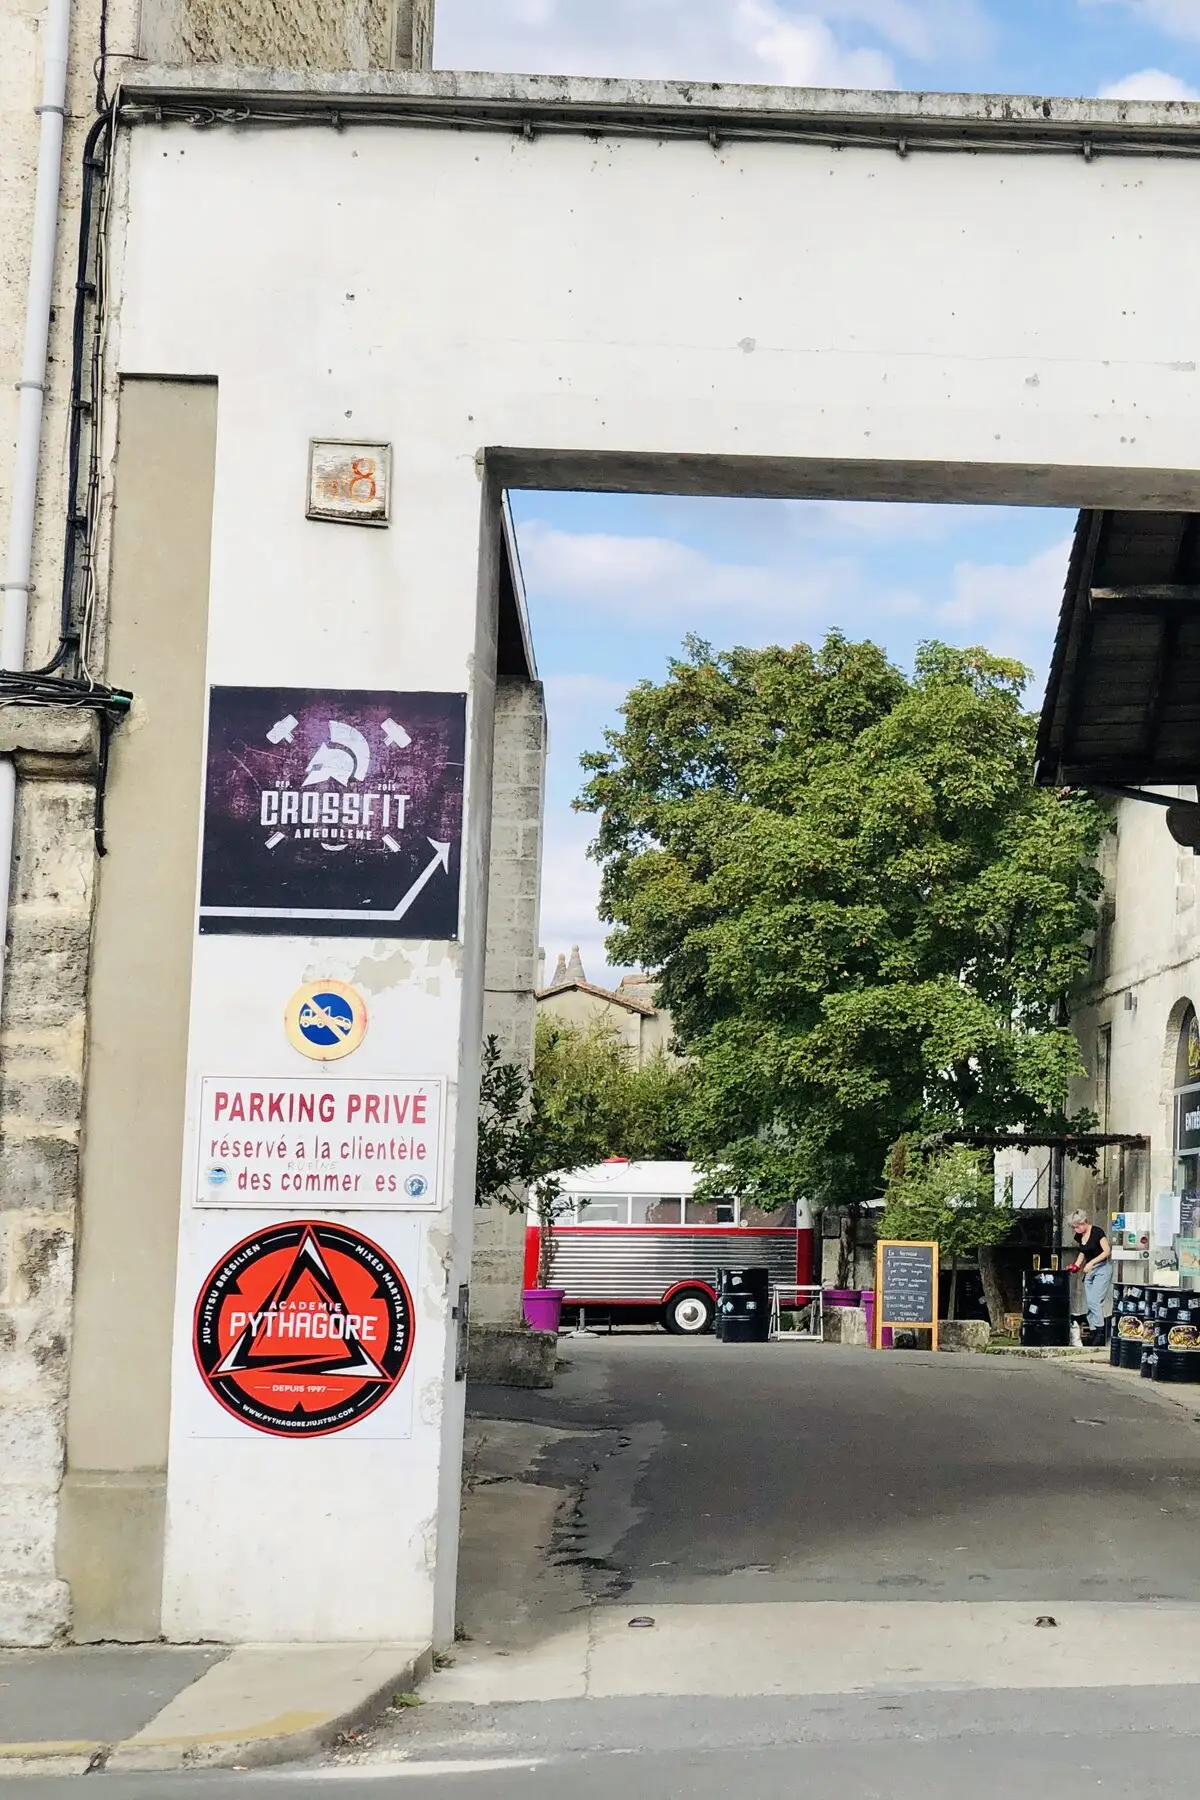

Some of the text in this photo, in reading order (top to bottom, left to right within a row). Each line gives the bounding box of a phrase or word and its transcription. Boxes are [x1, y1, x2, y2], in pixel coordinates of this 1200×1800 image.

[260, 790, 411, 829] CROSSFIT
[294, 828, 372, 840] ANGOULEME
[214, 1087, 428, 1124] PARKING PRIVÉ
[210, 1134, 287, 1159] réservé
[314, 1136, 331, 1160] la
[340, 1135, 427, 1161] clientèle
[237, 1166, 272, 1191] des
[202, 1243, 261, 1345] JIU-JITSU BRÉSILIEN
[268, 1300, 342, 1312] ACADEMIE
[355, 1244, 405, 1353] MIXED MARTIAL ARTS
[229, 1311, 379, 1341] PYTHAGORE
[272, 1384, 327, 1393] DEPUIS 1997
[242, 1403, 355, 1428] WWW.PYTHAGOREJIUJITSU.COM
